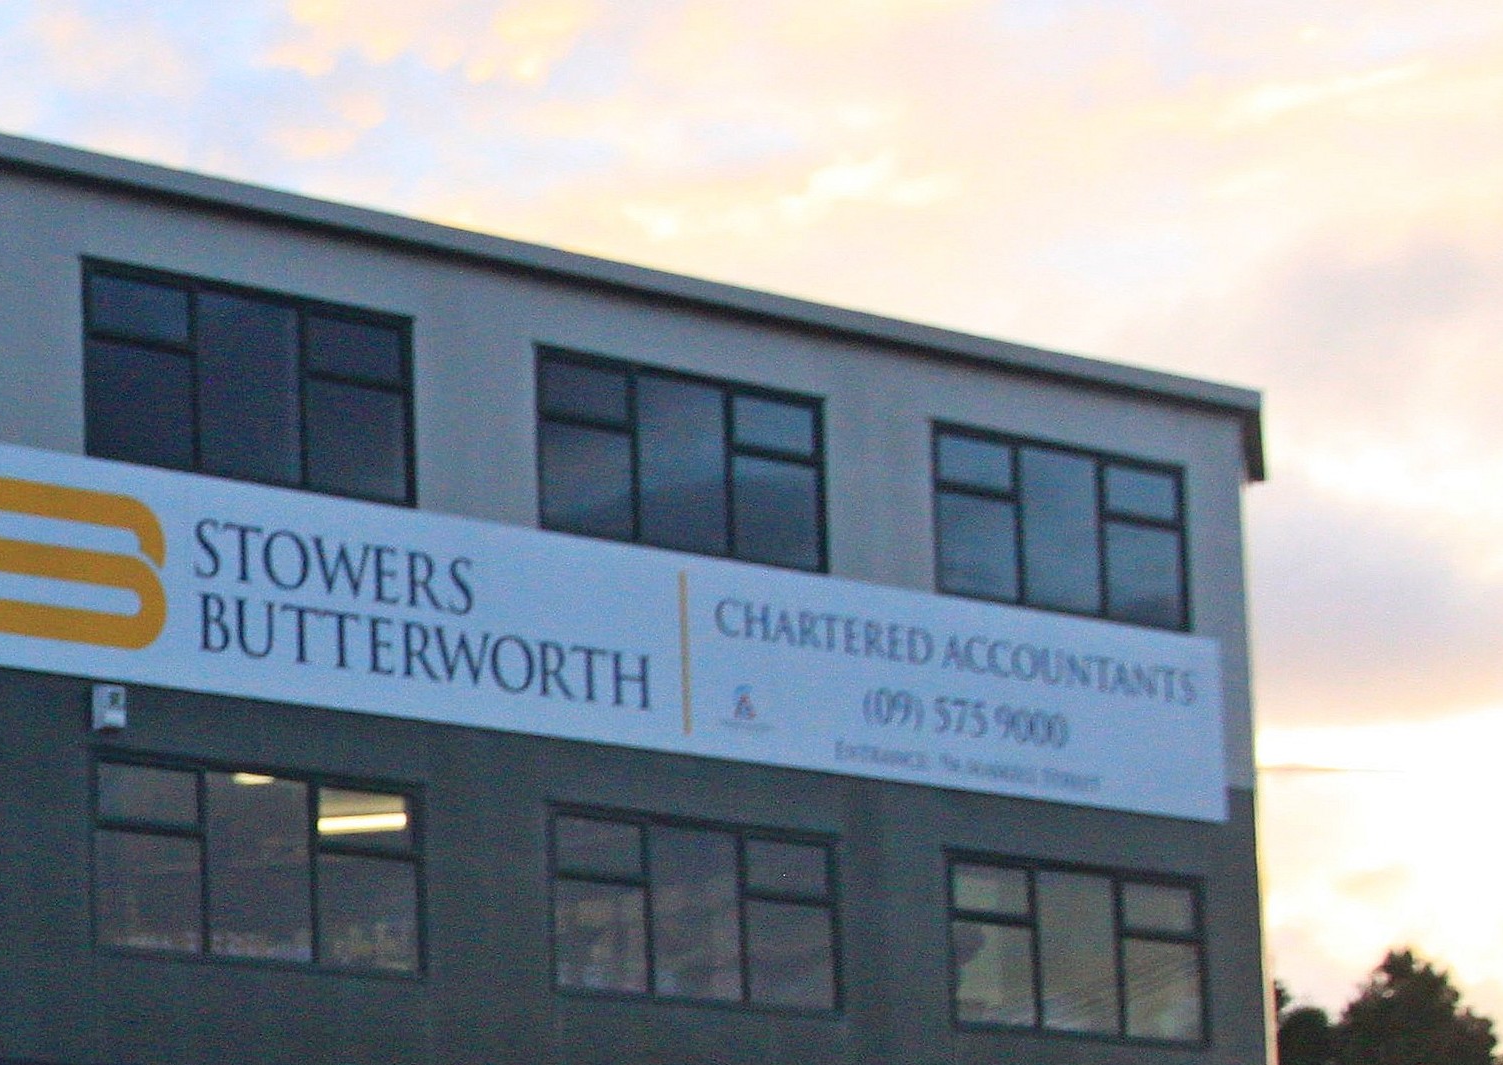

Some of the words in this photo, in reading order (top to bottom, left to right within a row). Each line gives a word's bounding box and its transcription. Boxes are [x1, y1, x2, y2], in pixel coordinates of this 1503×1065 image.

[194, 517, 474, 615] STOWERS
[200, 593, 650, 710] BUTTERWORTH
[714, 597, 935, 666] CHARTERED
[942, 635, 1197, 707] ACCOUNTANTS
[862, 687, 925, 732] (09)
[934, 696, 989, 739] 575
[994, 703, 1071, 749] 9000
